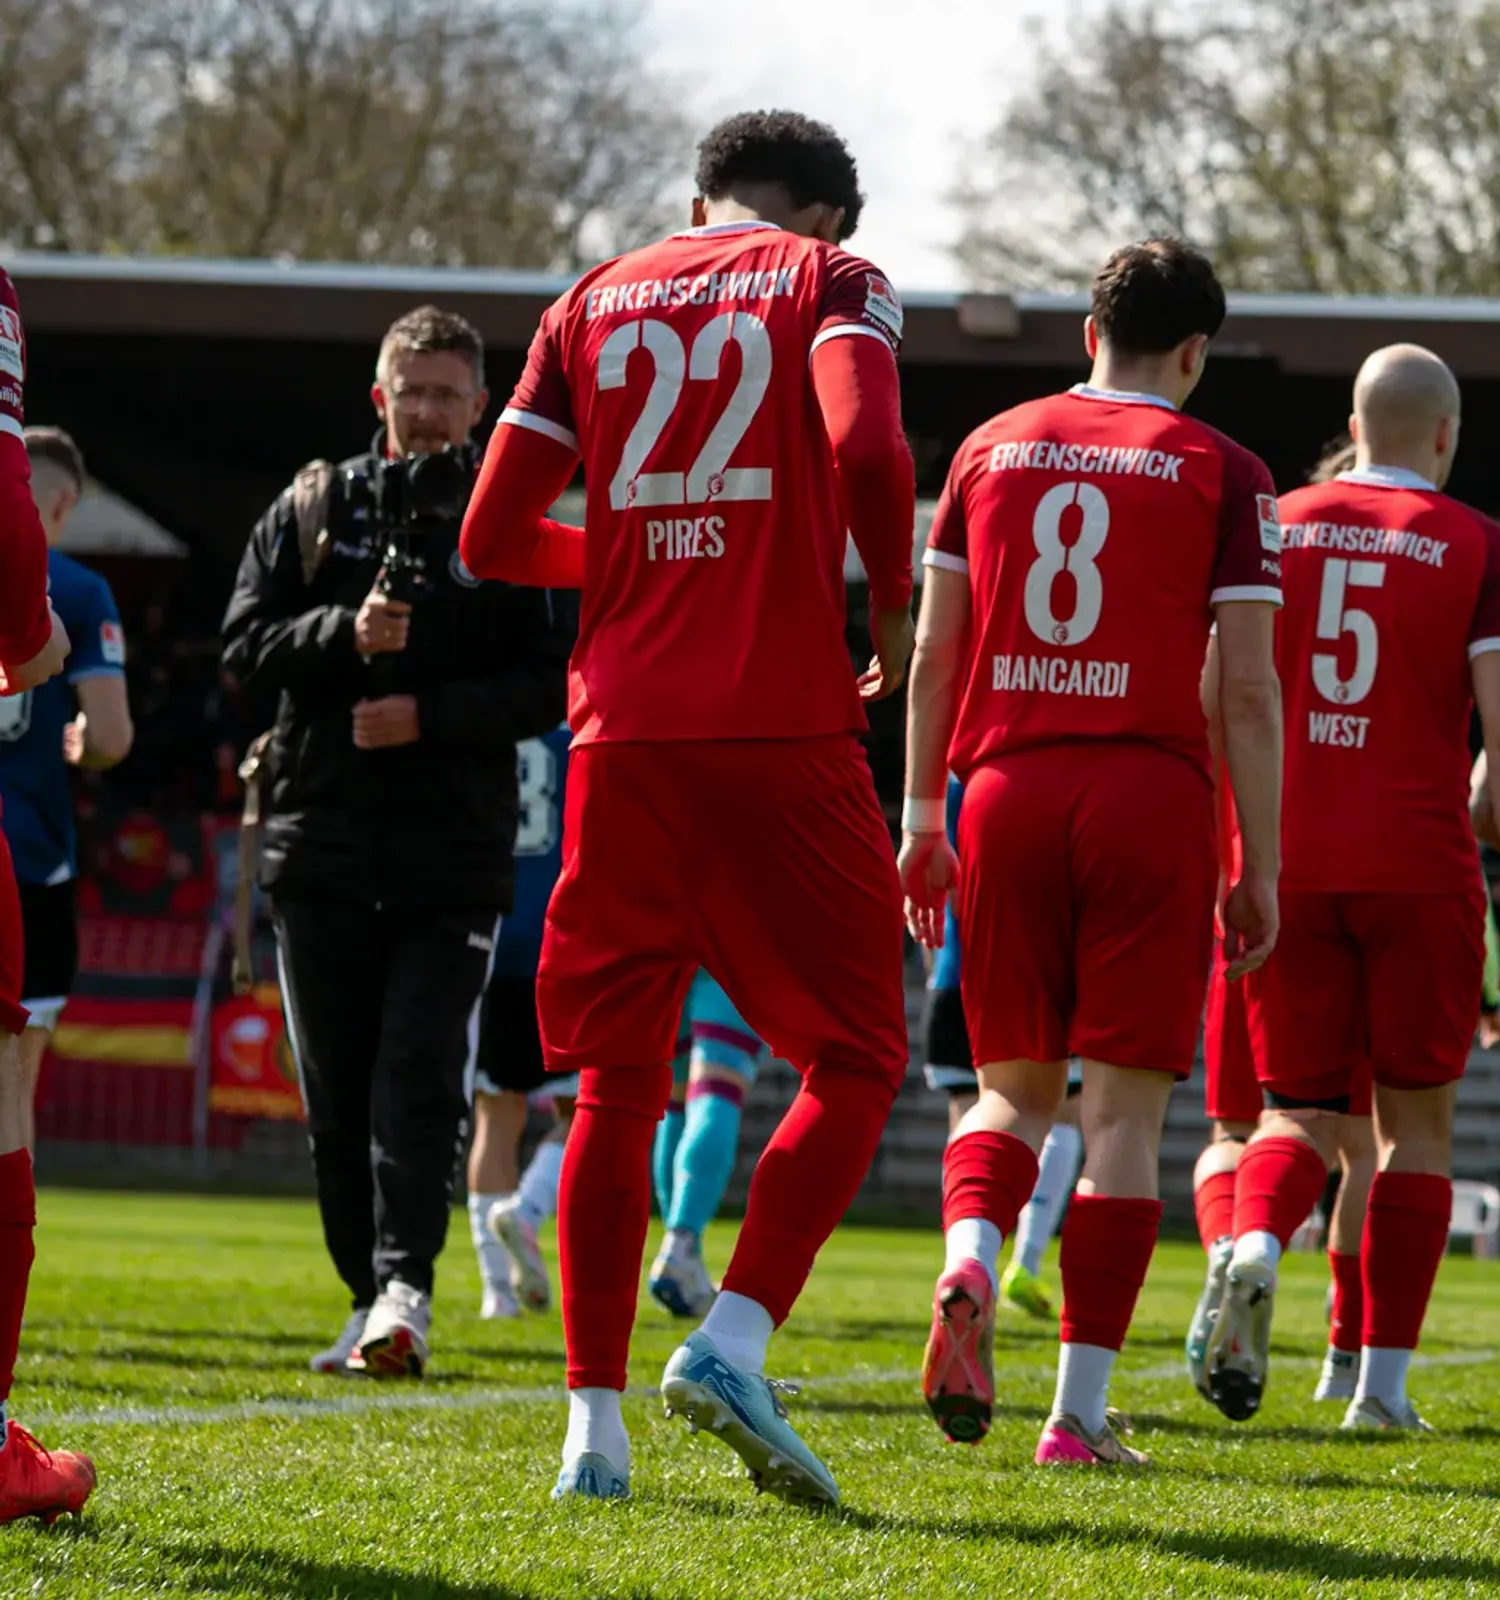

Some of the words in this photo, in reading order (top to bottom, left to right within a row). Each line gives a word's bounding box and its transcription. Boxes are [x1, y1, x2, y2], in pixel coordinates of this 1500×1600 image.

[586, 266, 798, 320] ERKENSCHWICK
[597, 311, 773, 510] 22
[989, 440, 1184, 482] ERKENSCHWICK
[647, 515, 726, 561] PIRES
[1281, 522, 1449, 568] ERKENSCHWICK
[1024, 482, 1110, 645] 8
[1312, 557, 1386, 705] 5
[992, 654, 1130, 697] BIANCARDI
[1308, 711, 1370, 749] WEST
